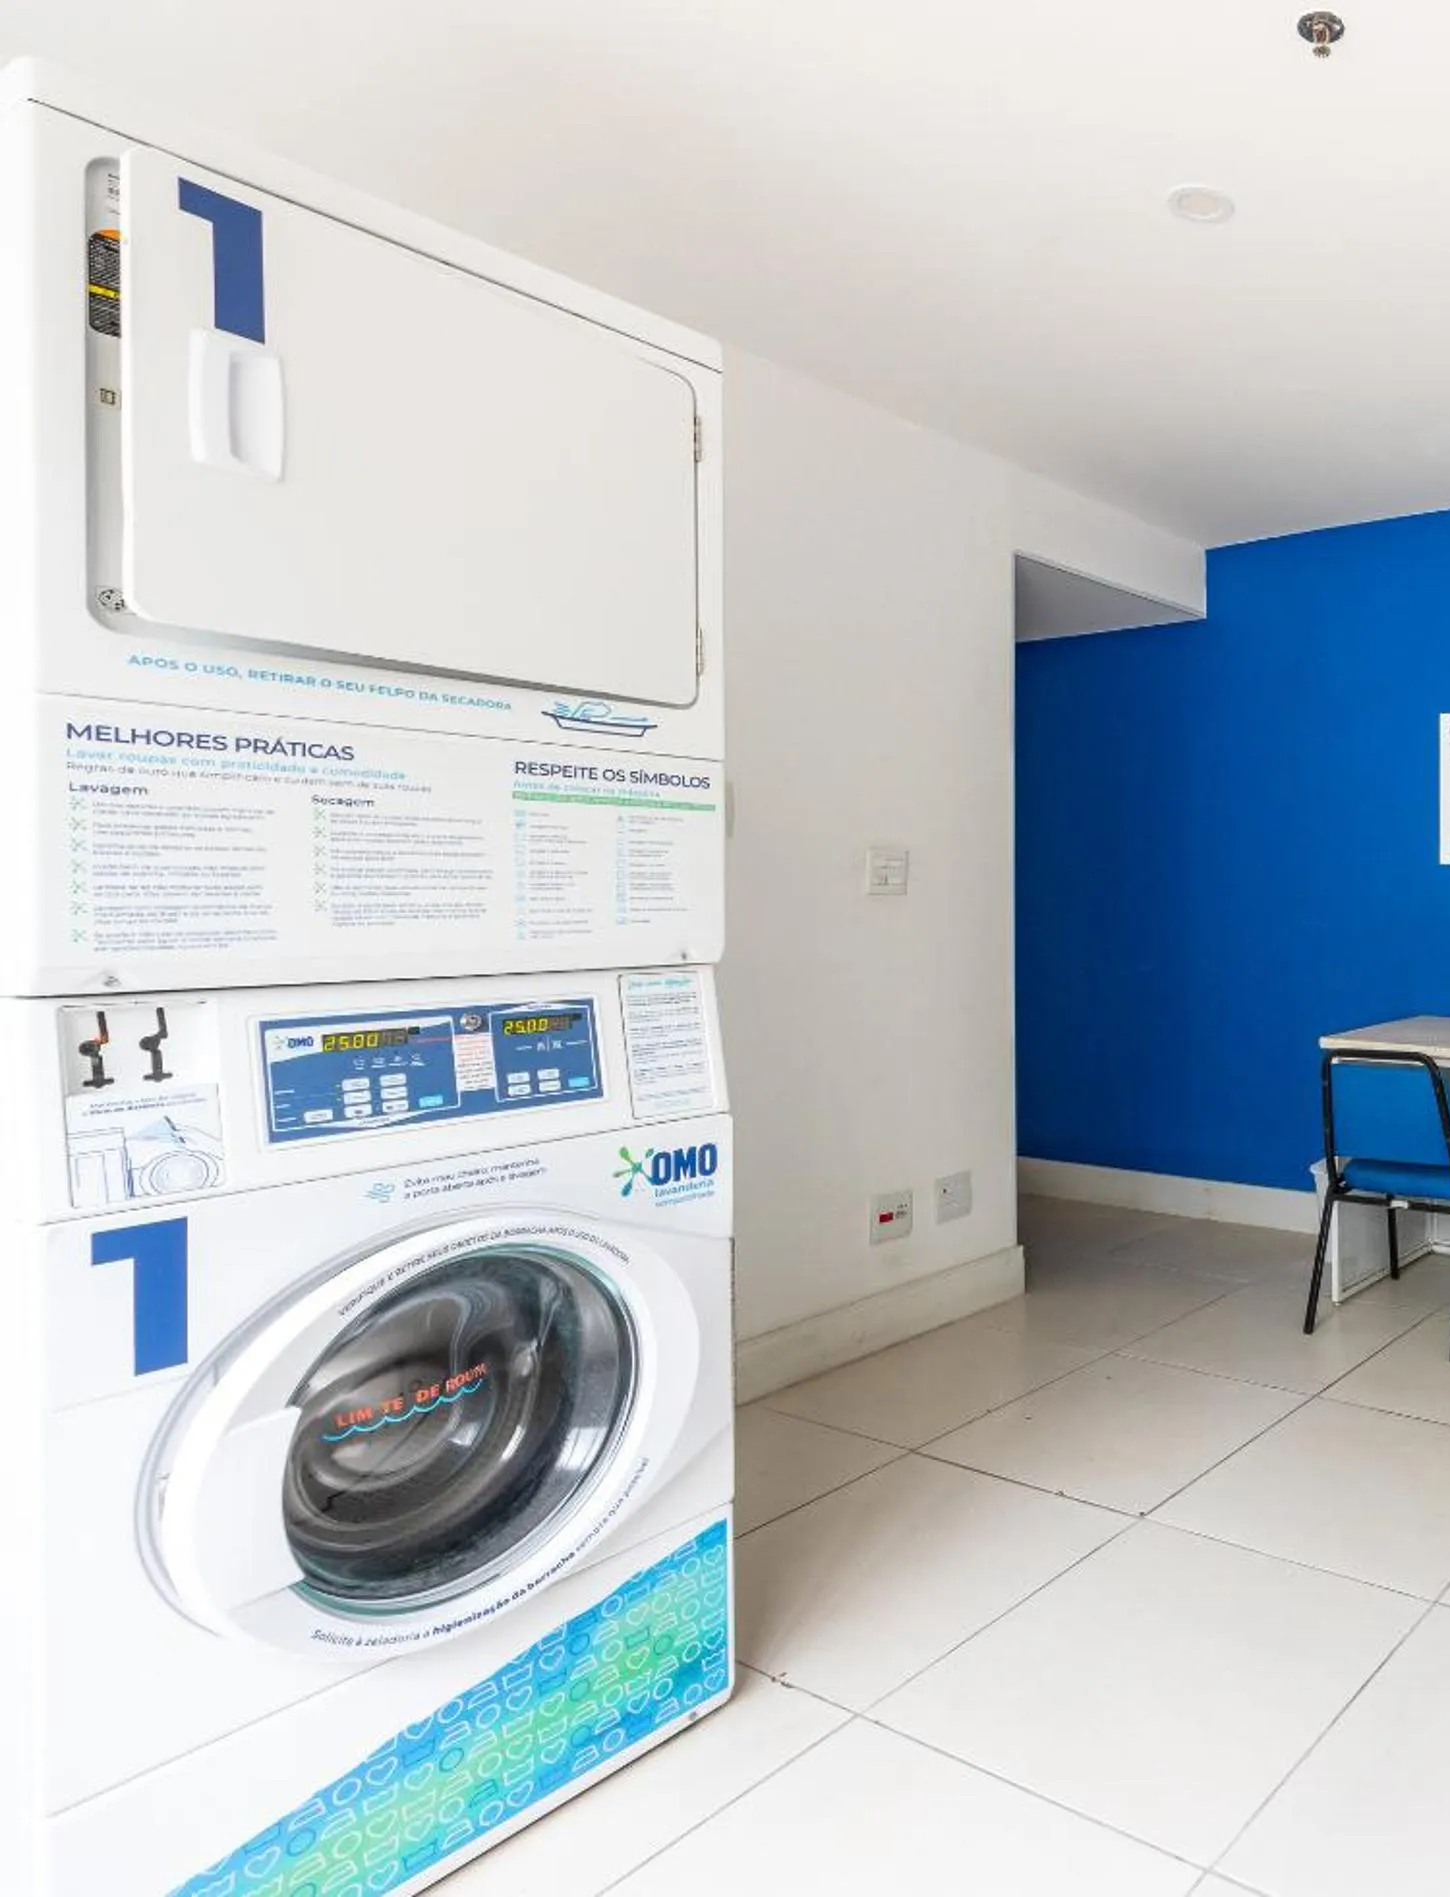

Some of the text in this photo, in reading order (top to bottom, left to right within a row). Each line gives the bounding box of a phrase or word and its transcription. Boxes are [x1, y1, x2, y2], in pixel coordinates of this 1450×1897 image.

[178, 176, 265, 345] 1
[184, 661, 198, 673] O
[248, 669, 317, 688] RETIRAR
[320, 677, 332, 689] O
[336, 680, 365, 693] SEU
[419, 691, 438, 702] DA
[442, 694, 512, 711] SECADORA
[66, 722, 355, 761] MELHORES PRÁTICAS
[182, 757, 216, 768] com
[514, 761, 711, 790] RESPEITE OS SÍMBOLOS
[68, 781, 149, 797] Lavagem
[650, 1142, 718, 1186] OMO
[91, 1215, 188, 1377] 1
[415, 1383, 441, 1403] DE
